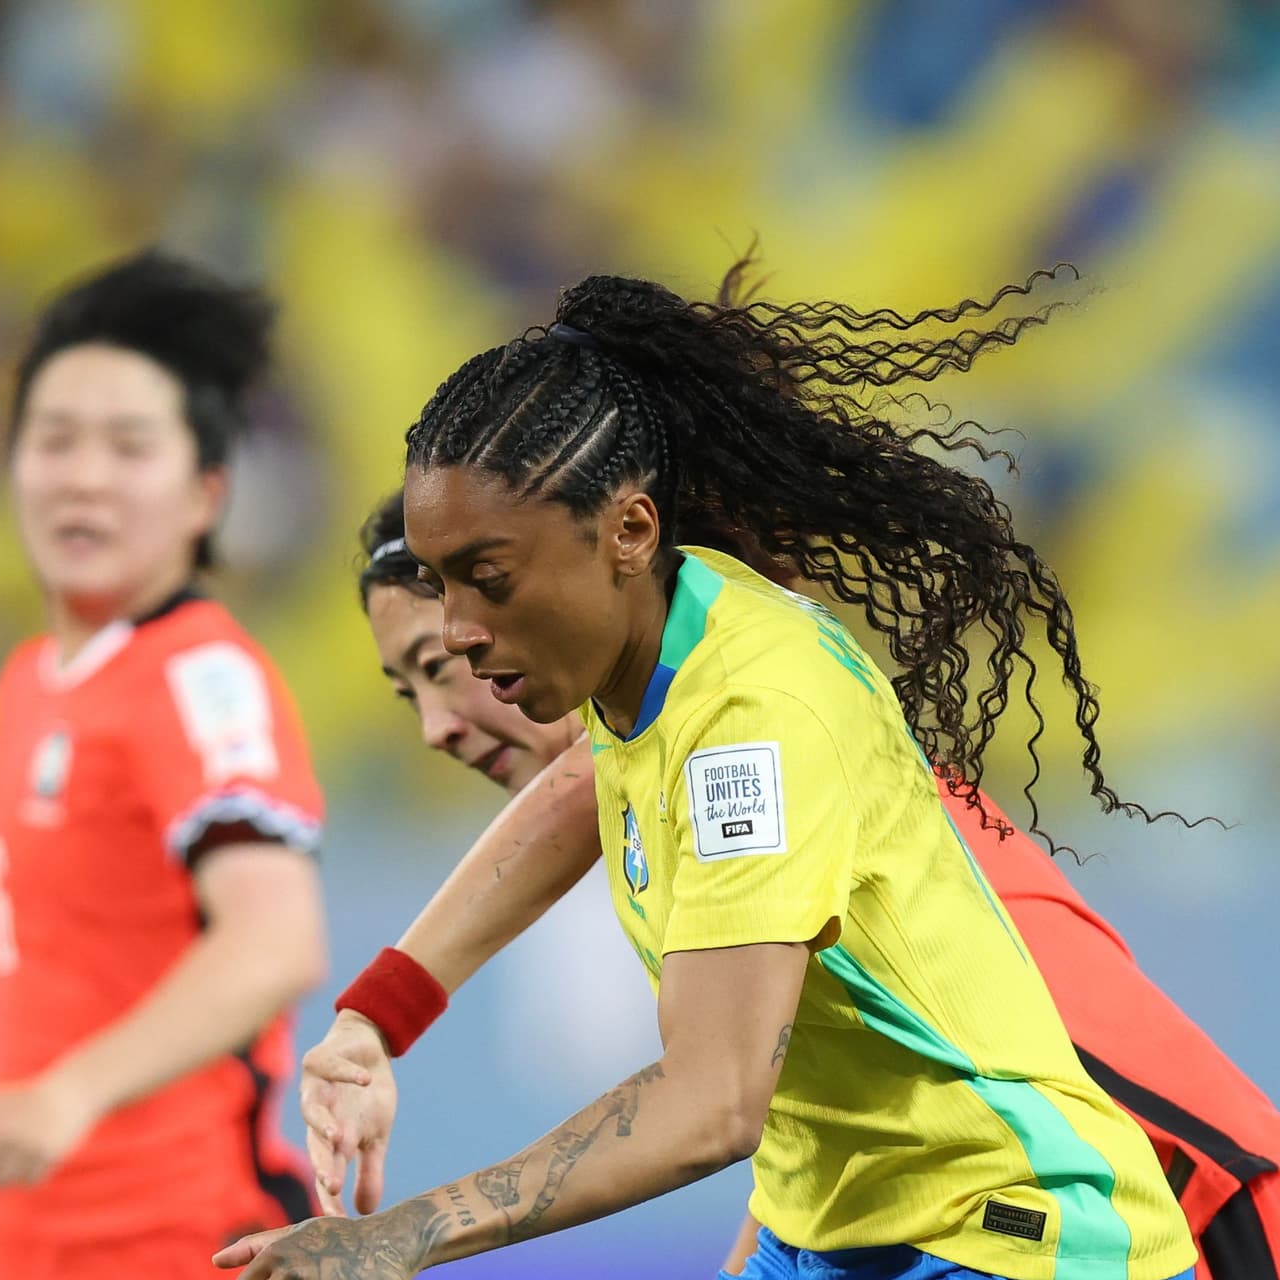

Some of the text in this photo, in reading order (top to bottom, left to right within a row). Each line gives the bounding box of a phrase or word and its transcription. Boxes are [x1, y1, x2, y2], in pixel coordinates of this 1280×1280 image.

[704, 763, 761, 783] FOOTBALL
[705, 778, 762, 803] UNITES
[704, 798, 767, 822] the World
[724, 823, 750, 836] FIFA
